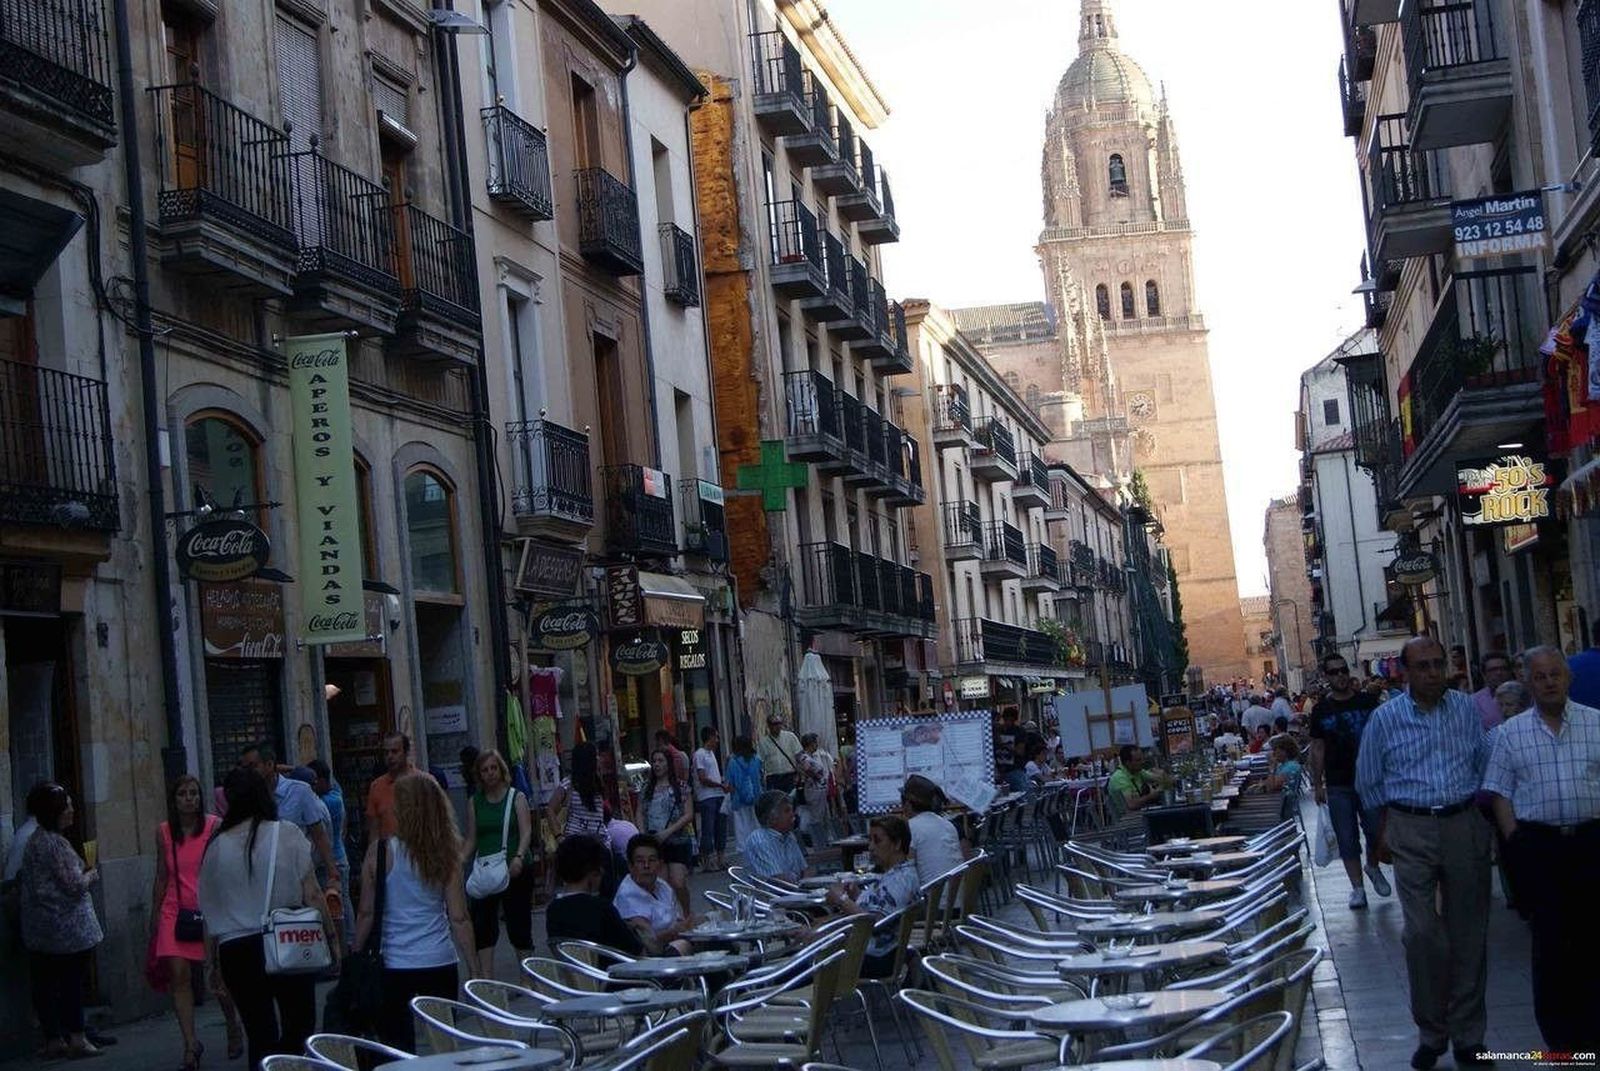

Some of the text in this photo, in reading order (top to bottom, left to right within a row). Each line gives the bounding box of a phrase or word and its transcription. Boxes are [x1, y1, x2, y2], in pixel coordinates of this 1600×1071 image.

[1485, 196, 1536, 214] Martín
[1455, 216, 1544, 241] 923 12 54 48
[1456, 232, 1545, 256] INFORMA
[308, 374, 342, 605] APEROS Y VIANDAS
[1480, 488, 1549, 522] ROCK
[681, 630, 699, 644] SECOS
[679, 653, 706, 669] REGALOS
